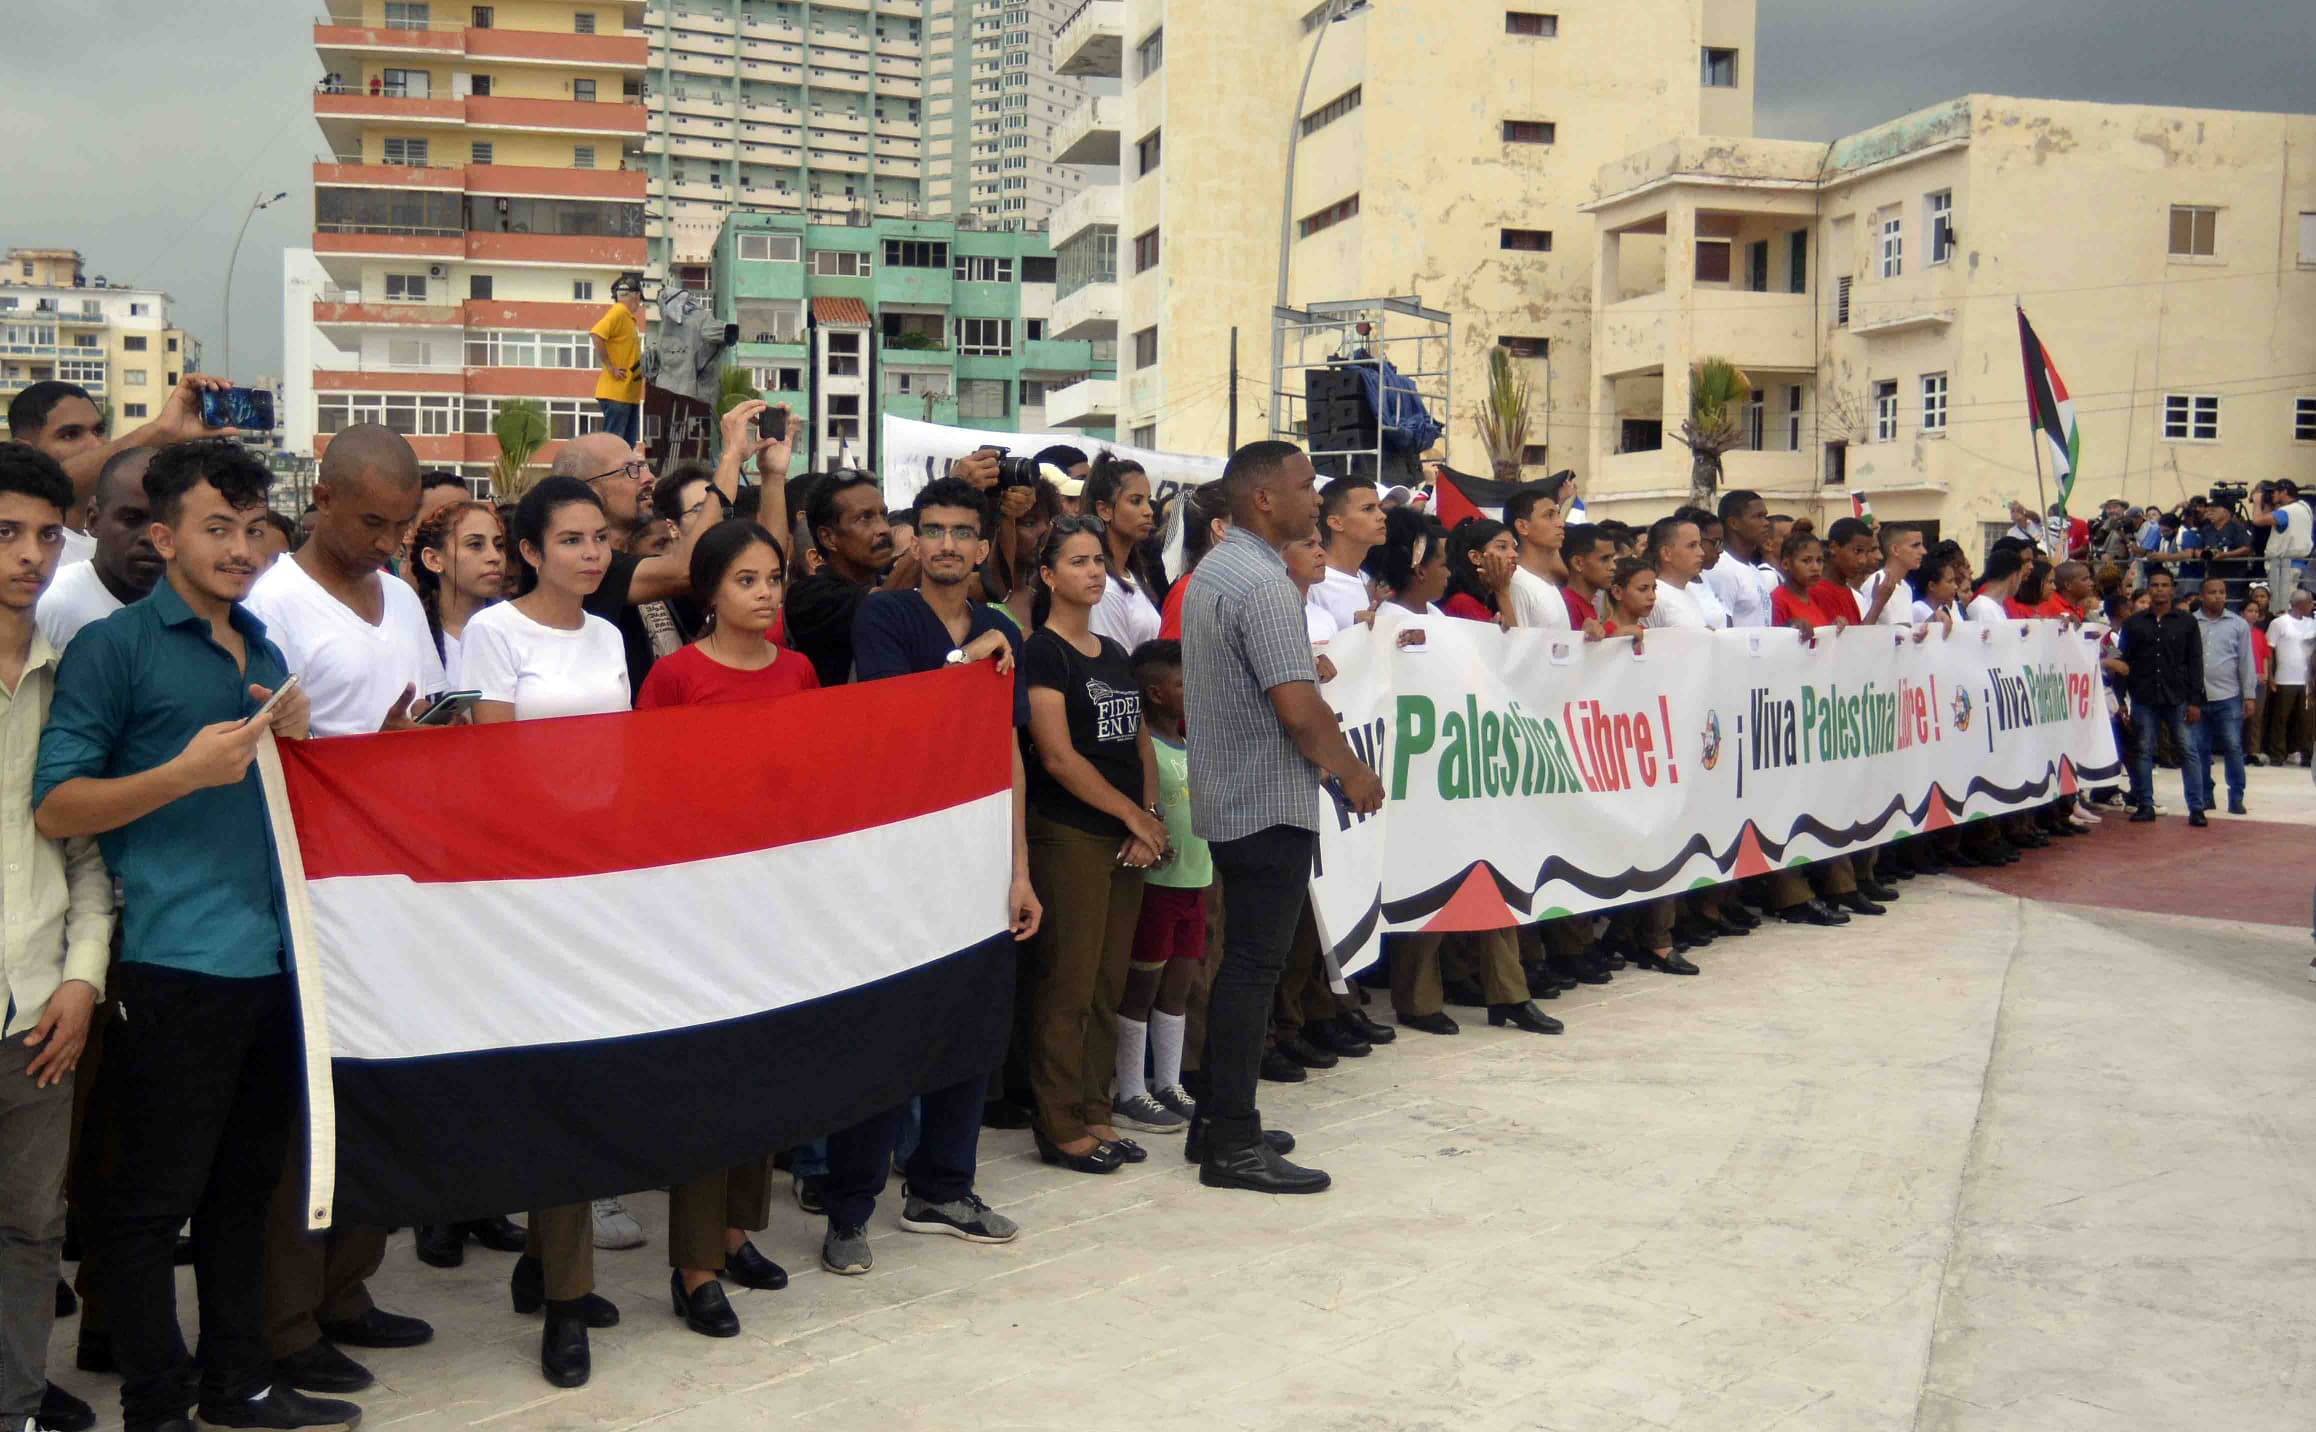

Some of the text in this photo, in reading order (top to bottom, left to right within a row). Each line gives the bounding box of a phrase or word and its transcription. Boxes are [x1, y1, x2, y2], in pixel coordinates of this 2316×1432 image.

[1097, 696, 1141, 720] FIDEL
[1097, 717, 1122, 738] EN
[1801, 681, 1895, 763] Palestina
[1390, 694, 1583, 800] Palestina
